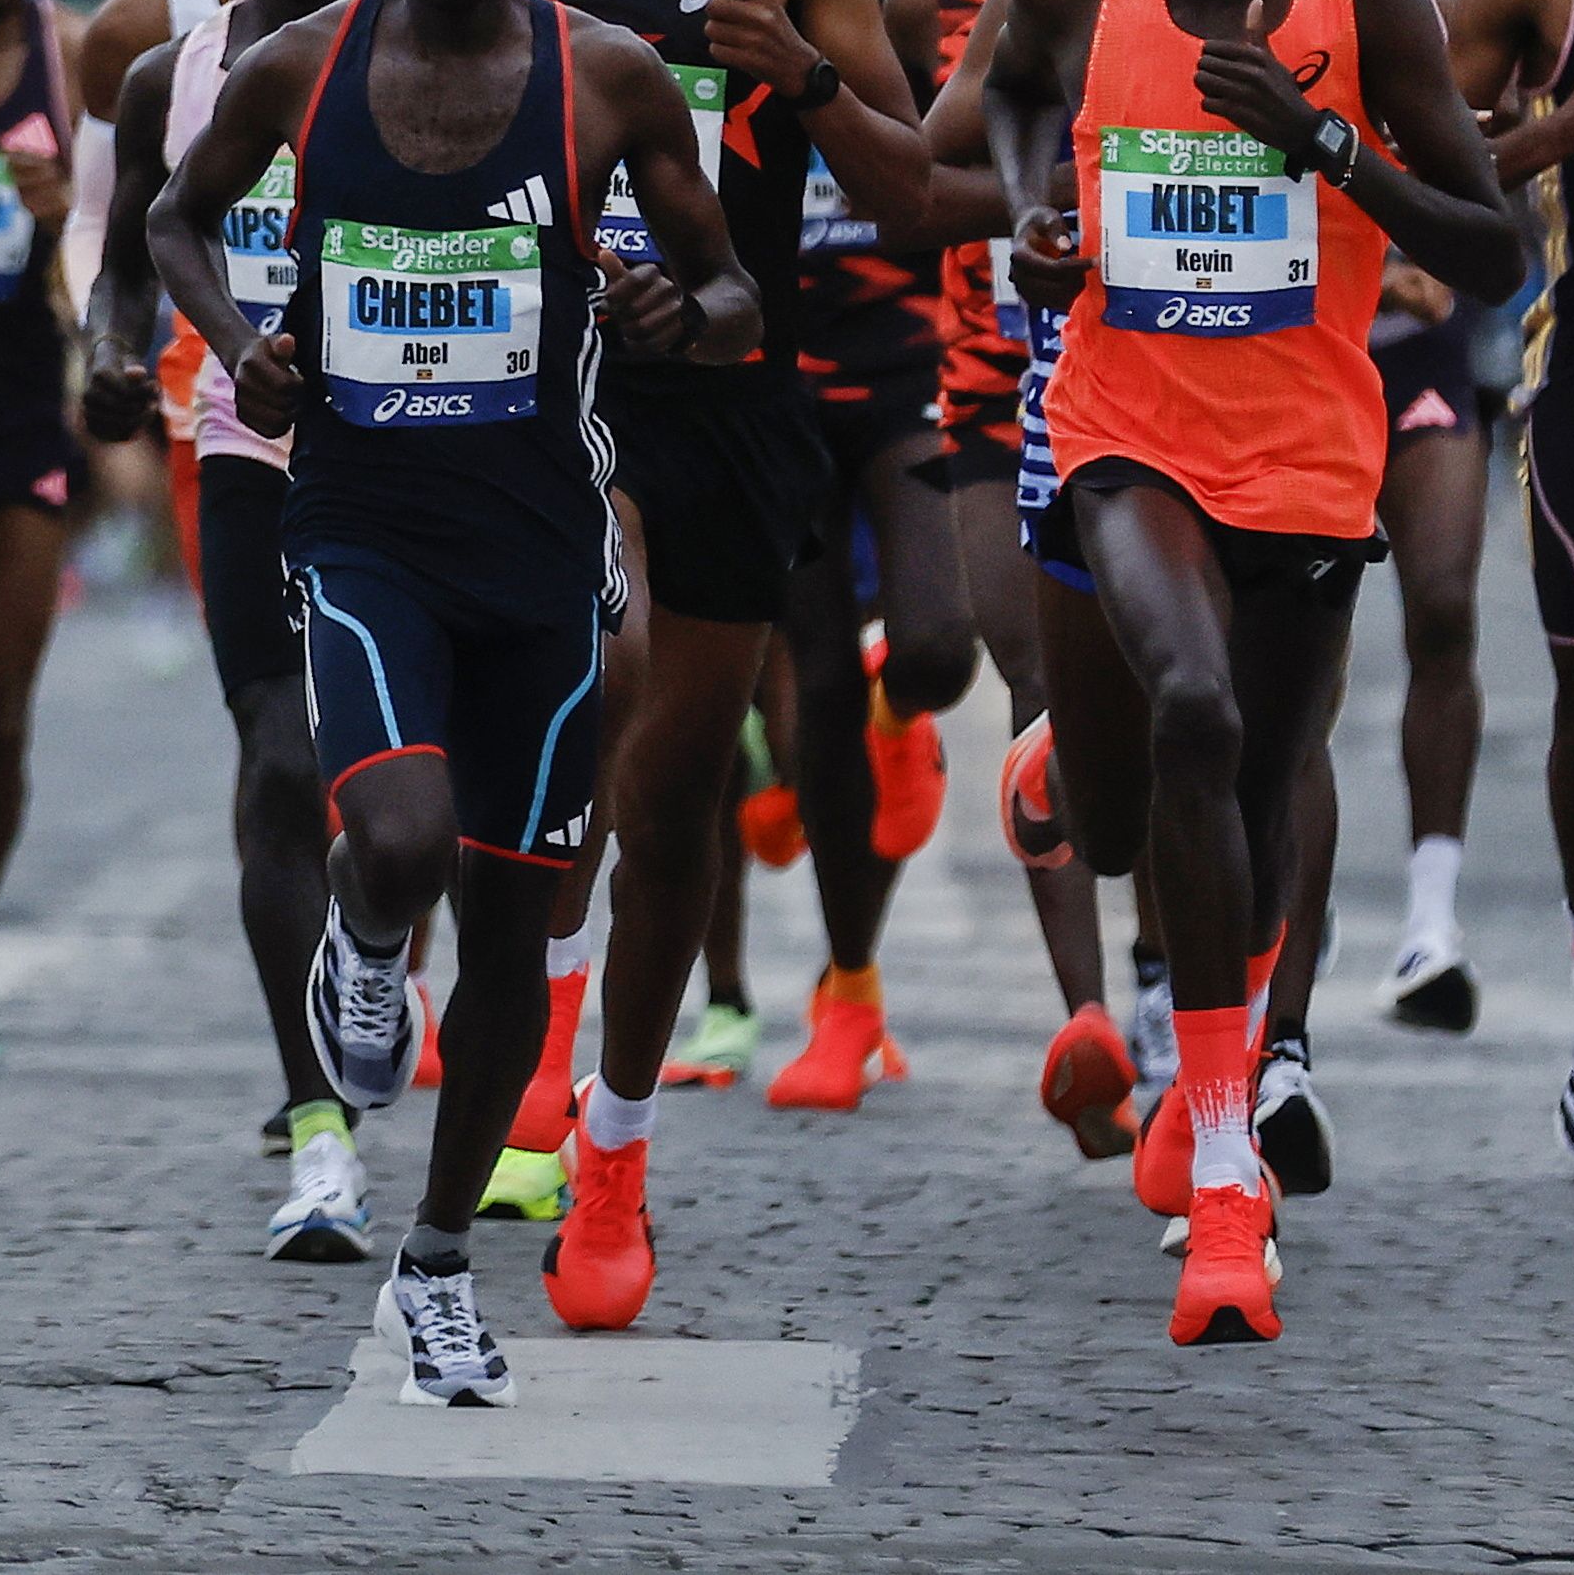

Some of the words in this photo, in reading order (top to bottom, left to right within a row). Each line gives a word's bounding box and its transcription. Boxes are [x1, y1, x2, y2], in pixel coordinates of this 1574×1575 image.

[1140, 129, 1269, 157] Schneider
[1195, 157, 1269, 173] Electric
[1151, 183, 1261, 234] KIBET
[361, 225, 495, 256] Schneider
[417, 255, 490, 269] Electric
[1176, 248, 1233, 273] Kevin
[1288, 259, 1309, 282] 31
[357, 276, 499, 328] CHEBET
[1186, 304, 1252, 327] asics
[402, 342, 448, 365] Abel
[506, 349, 530, 374] 30
[405, 394, 472, 416] asics
